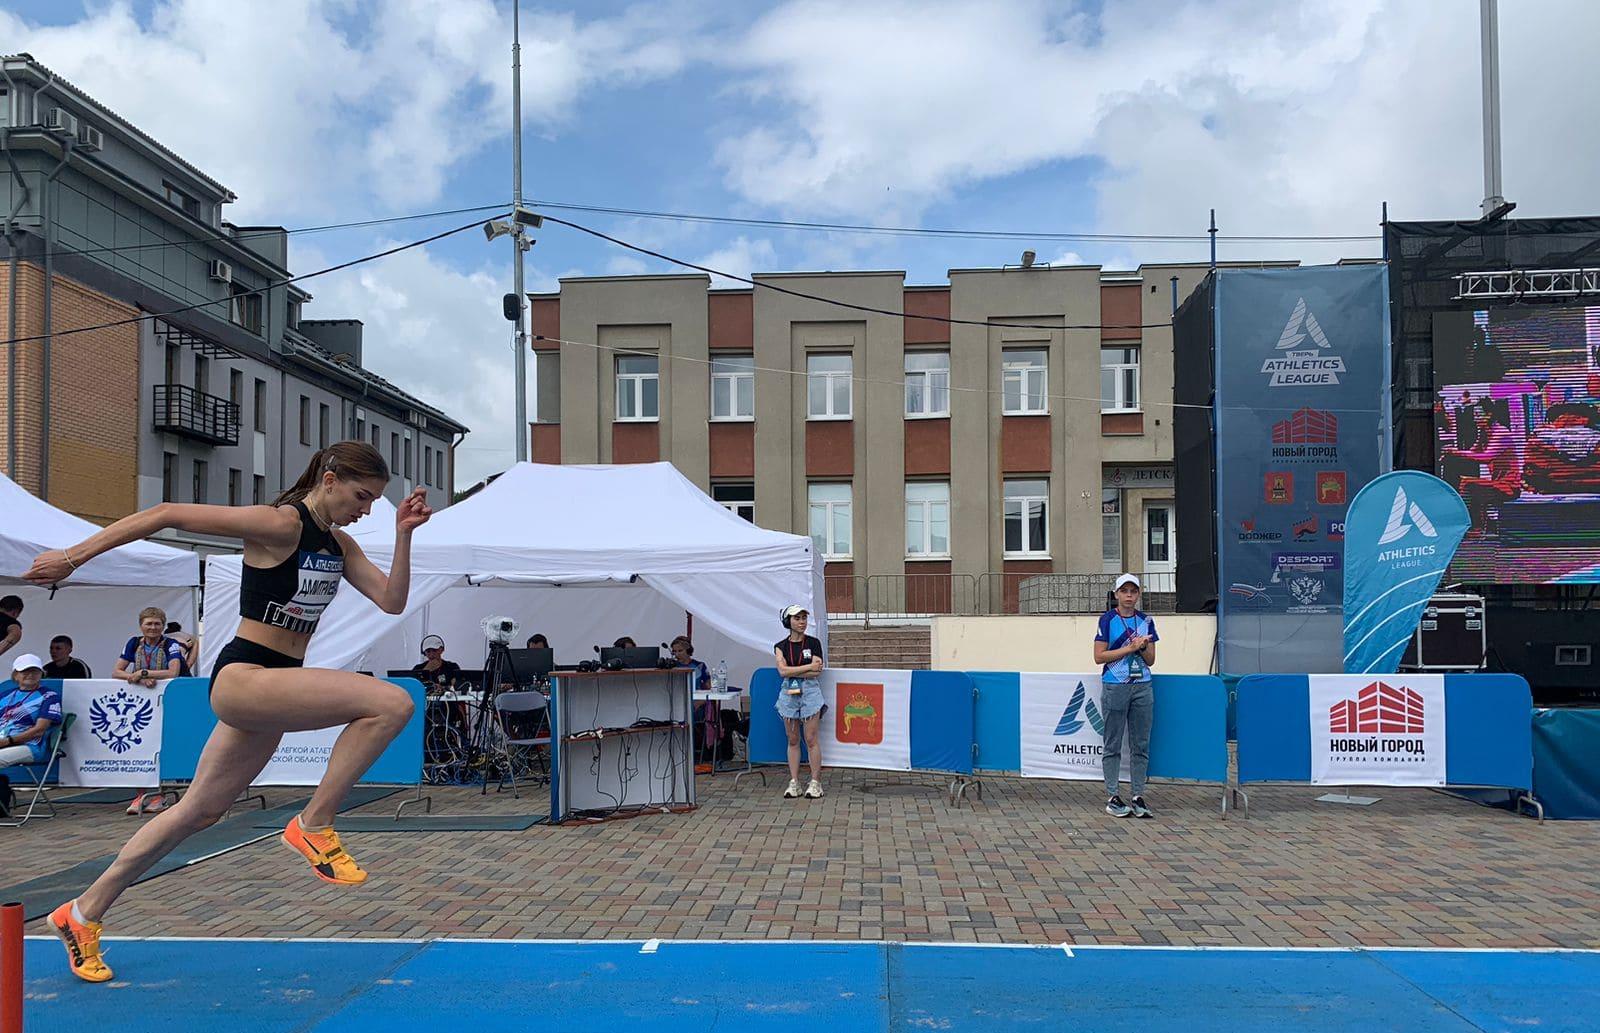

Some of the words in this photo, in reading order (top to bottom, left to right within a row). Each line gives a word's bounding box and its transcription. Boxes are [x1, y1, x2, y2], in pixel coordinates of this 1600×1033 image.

[1265, 360, 1340, 371] ATHLETICS
[1277, 373, 1330, 384] LEAGUE
[1272, 444, 1306, 457] НОВЫЙ
[1308, 447, 1338, 458] ГОРОД
[1278, 555, 1334, 563] DESPORT
[1378, 545, 1436, 562] ATHLETICS
[1391, 560, 1423, 570] LEAGUE
[280, 746, 309, 754] ЛЕГКОЙ
[1330, 736, 1378, 752] НОВЫЙ
[1381, 739, 1425, 755] ГОРОД
[1067, 757, 1096, 766] LEAGUE
